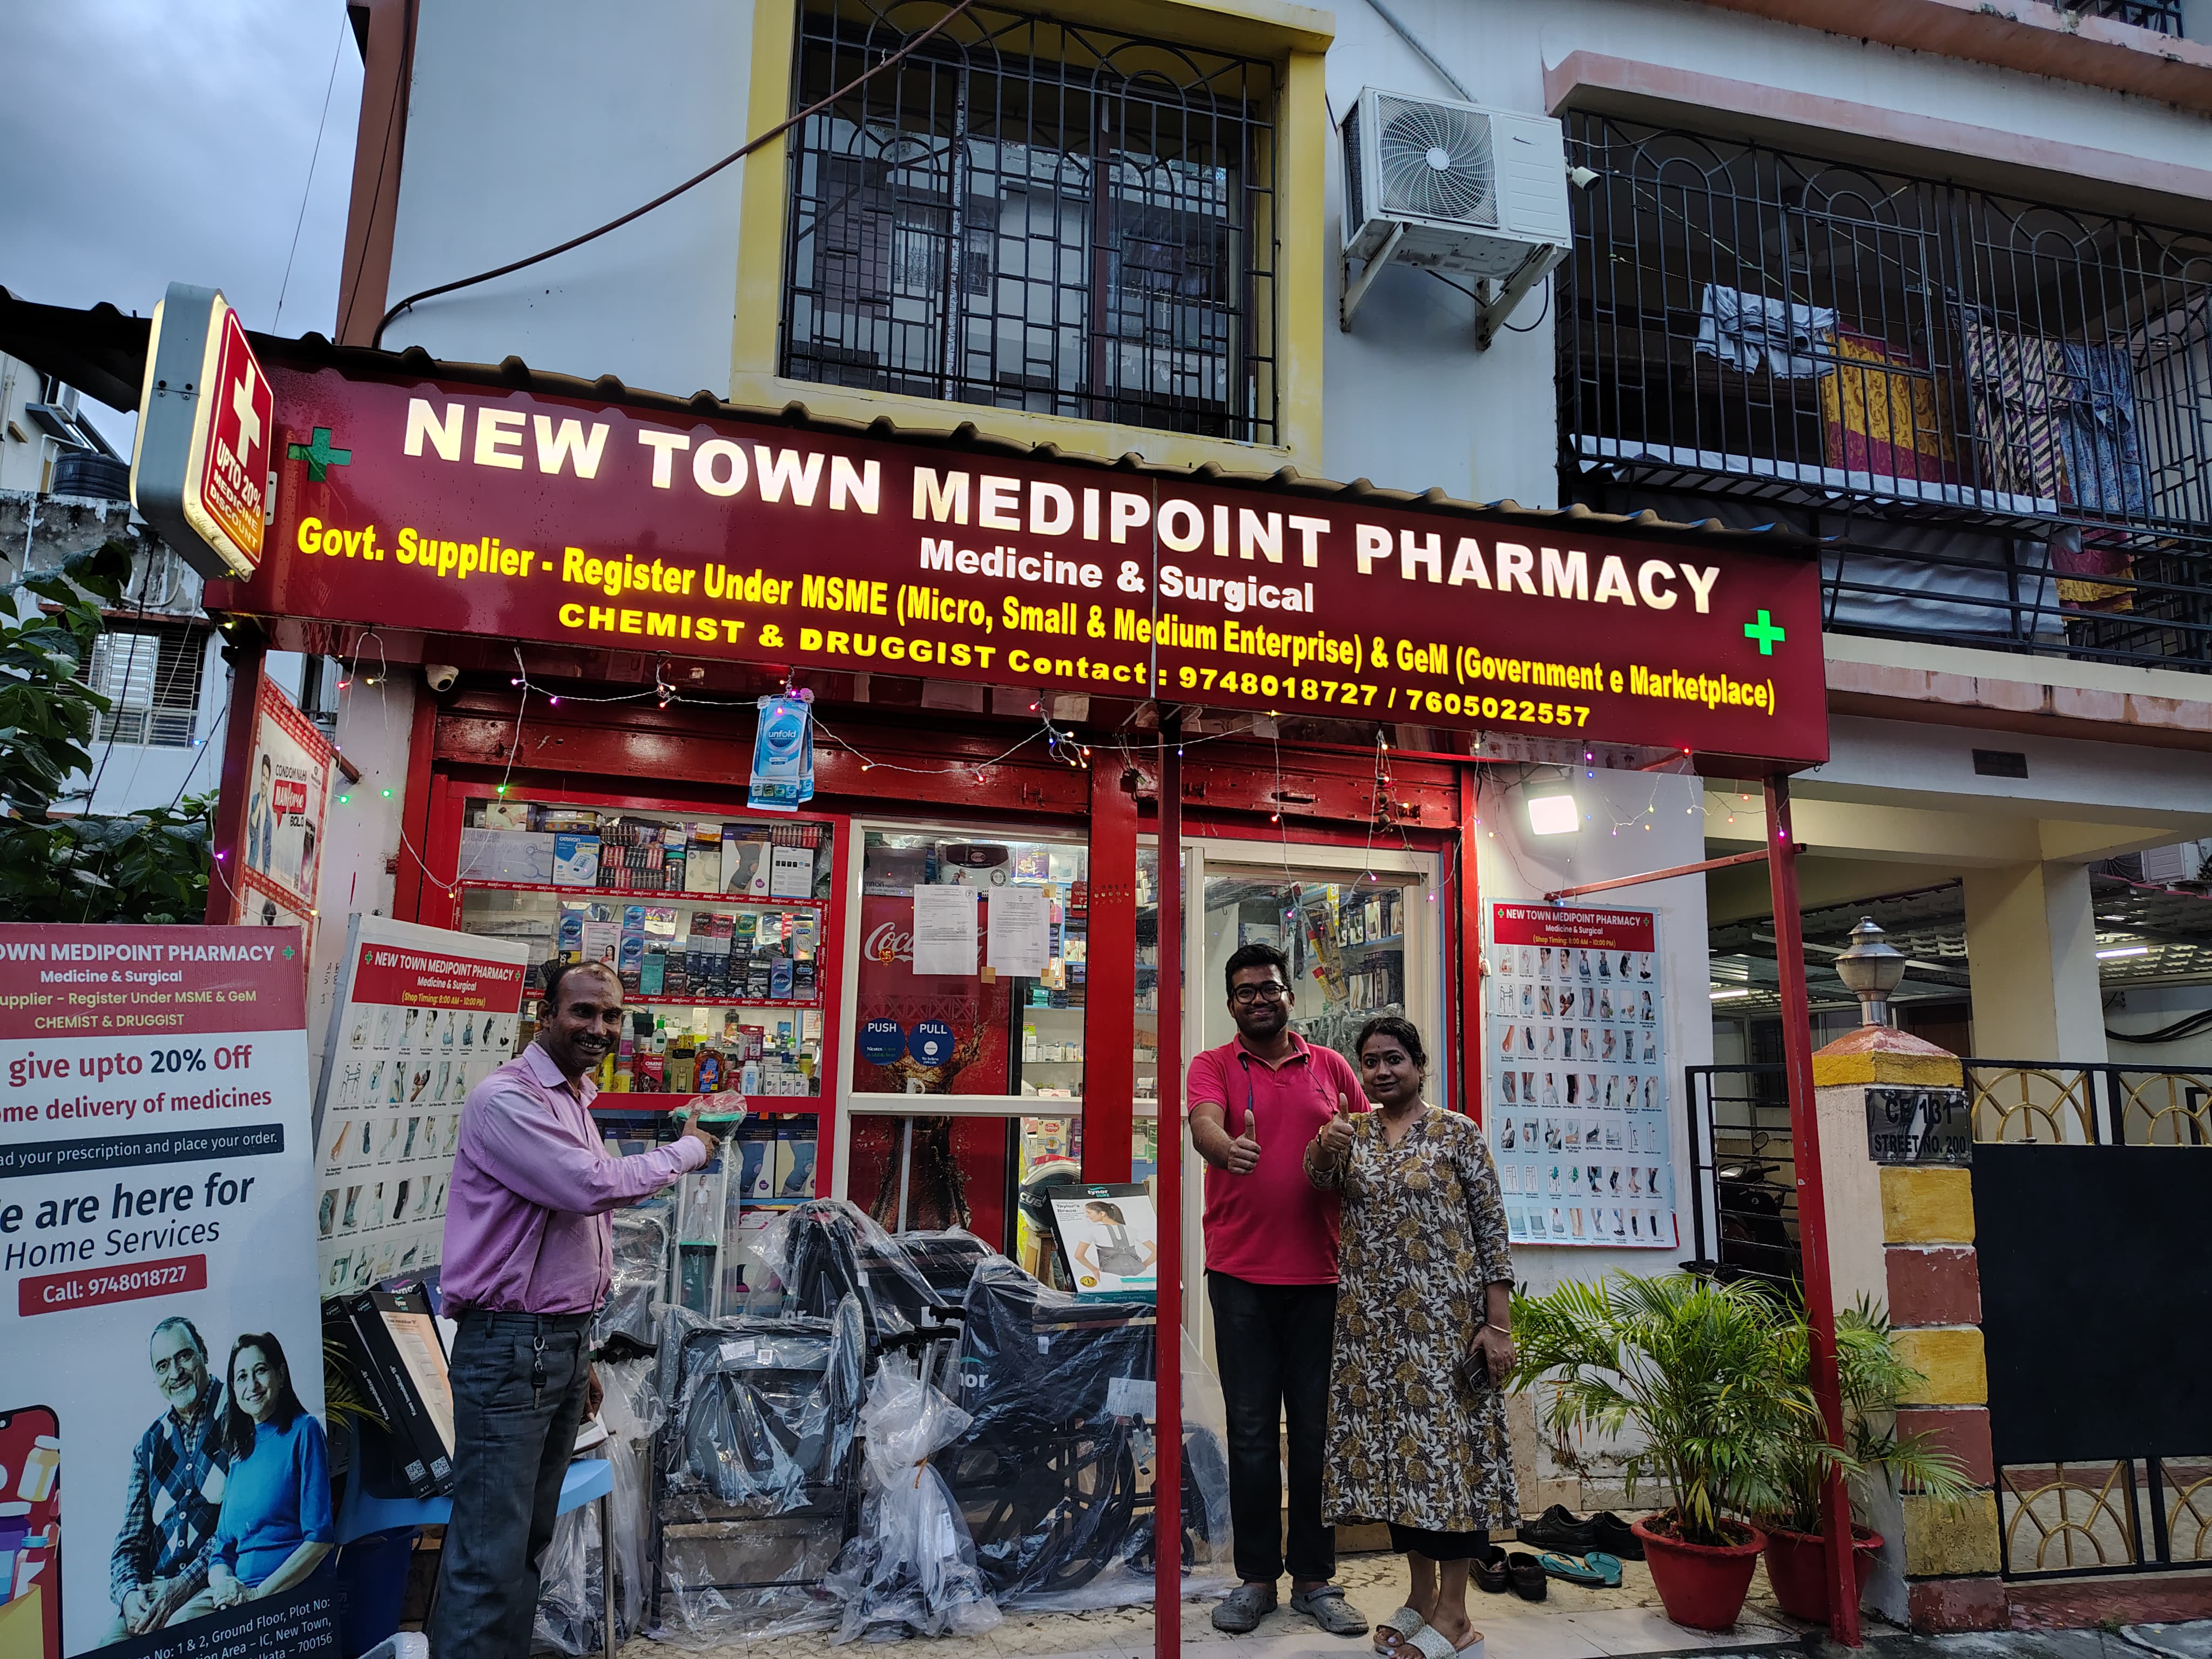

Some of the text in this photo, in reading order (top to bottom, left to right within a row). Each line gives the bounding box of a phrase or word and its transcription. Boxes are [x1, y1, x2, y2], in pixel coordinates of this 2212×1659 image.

[216, 437, 261, 517] UPTO 20%
[210, 484, 258, 548] DISCOUNT
[214, 469, 258, 533] MEDICINE
[404, 399, 1720, 613] NEW TOWN MEDIPOINT PHARMACY
[920, 537, 1314, 612] Medicine & Surgical
[298, 517, 384, 561] Govt.
[396, 528, 535, 579] Supplier
[562, 547, 696, 596] Register
[704, 563, 793, 605] Under
[801, 574, 888, 615] MSME
[897, 584, 993, 634] (Micro,
[1002, 596, 1077, 635] Small
[1087, 605, 1106, 638] &
[1114, 608, 1217, 650] Medium
[1224, 620, 1362, 673] Enterprise)
[1371, 637, 1389, 668] &
[1397, 639, 1448, 675] GeM
[1456, 646, 1603, 691] (Government
[1610, 670, 1623, 693] e
[1630, 665, 1775, 716] Marketplace)
[559, 603, 745, 643] CHEMIST
[759, 624, 784, 648] &
[800, 628, 996, 668] DRUGGIST
[1008, 650, 1146, 684] Contact
[1179, 666, 1378, 706] 9748018727
[1388, 687, 1396, 708] /
[1406, 689, 1590, 727] 7605022557
[768, 730, 796, 738] unfold
[1506, 909, 1641, 926] NEW TOWN MEDIPOINT PHARMACY
[1545, 924, 1572, 934] Medicine
[1579, 926, 1603, 936] Surgical
[51, 944, 164, 961] MEDIPOINT
[168, 945, 275, 961] PHARMACY
[1533, 934, 1548, 945] (Shop
[1606, 939, 1616, 948] PM)
[41, 970, 182, 986] Medicine & Surgical
[374, 951, 514, 981] NEW TOWN MEDIPOINT PHARMACY
[69, 992, 127, 1008] Register
[131, 991, 172, 1004] Under
[175, 992, 213, 1003] MSME
[215, 992, 225, 1002] &
[228, 990, 257, 1002] GeM
[402, 990, 418, 1003] (Shop
[419, 993, 438, 1006] Timing:
[476, 998, 486, 1008] PM)
[417, 976, 477, 994] Medicine & Surgical
[35, 1014, 185, 1029] CHEMIST & DRUGGIST
[868, 1023, 896, 1033] PUSH
[920, 1024, 948, 1034] PULL
[9, 1044, 253, 1087] give upto 20% Off
[0, 1087, 272, 1123] me delivery of medicines
[1919, 1098, 1952, 1125] 131
[19, 1152, 52, 1168] your
[57, 1142, 140, 1164] prescription
[145, 1139, 170, 1154] and
[174, 1139, 208, 1157] place
[211, 1134, 239, 1151] your
[242, 1132, 278, 1146] order.
[1874, 1134, 1966, 1154] STREET NO. 200
[35, 1196, 99, 1230] are
[112, 1183, 194, 1219] here
[205, 1172, 256, 1208] for
[5, 1219, 220, 1271] Home Services
[43, 1265, 187, 1303] Call: 9748018727
[177, 1643, 183, 1654] 1
[187, 1640, 195, 1651] &
[199, 1636, 209, 1648] 2,
[212, 1619, 253, 1643] Ground
[257, 1611, 287, 1632] Floor,
[289, 1604, 310, 1622] Plot
[313, 1597, 331, 1611] No:
[221, 1645, 247, 1659] Area
[260, 1634, 273, 1649] IC,
[276, 1626, 298, 1642] New
[301, 1616, 331, 1633] Town,
[298, 1635, 333, 1653] 700156
